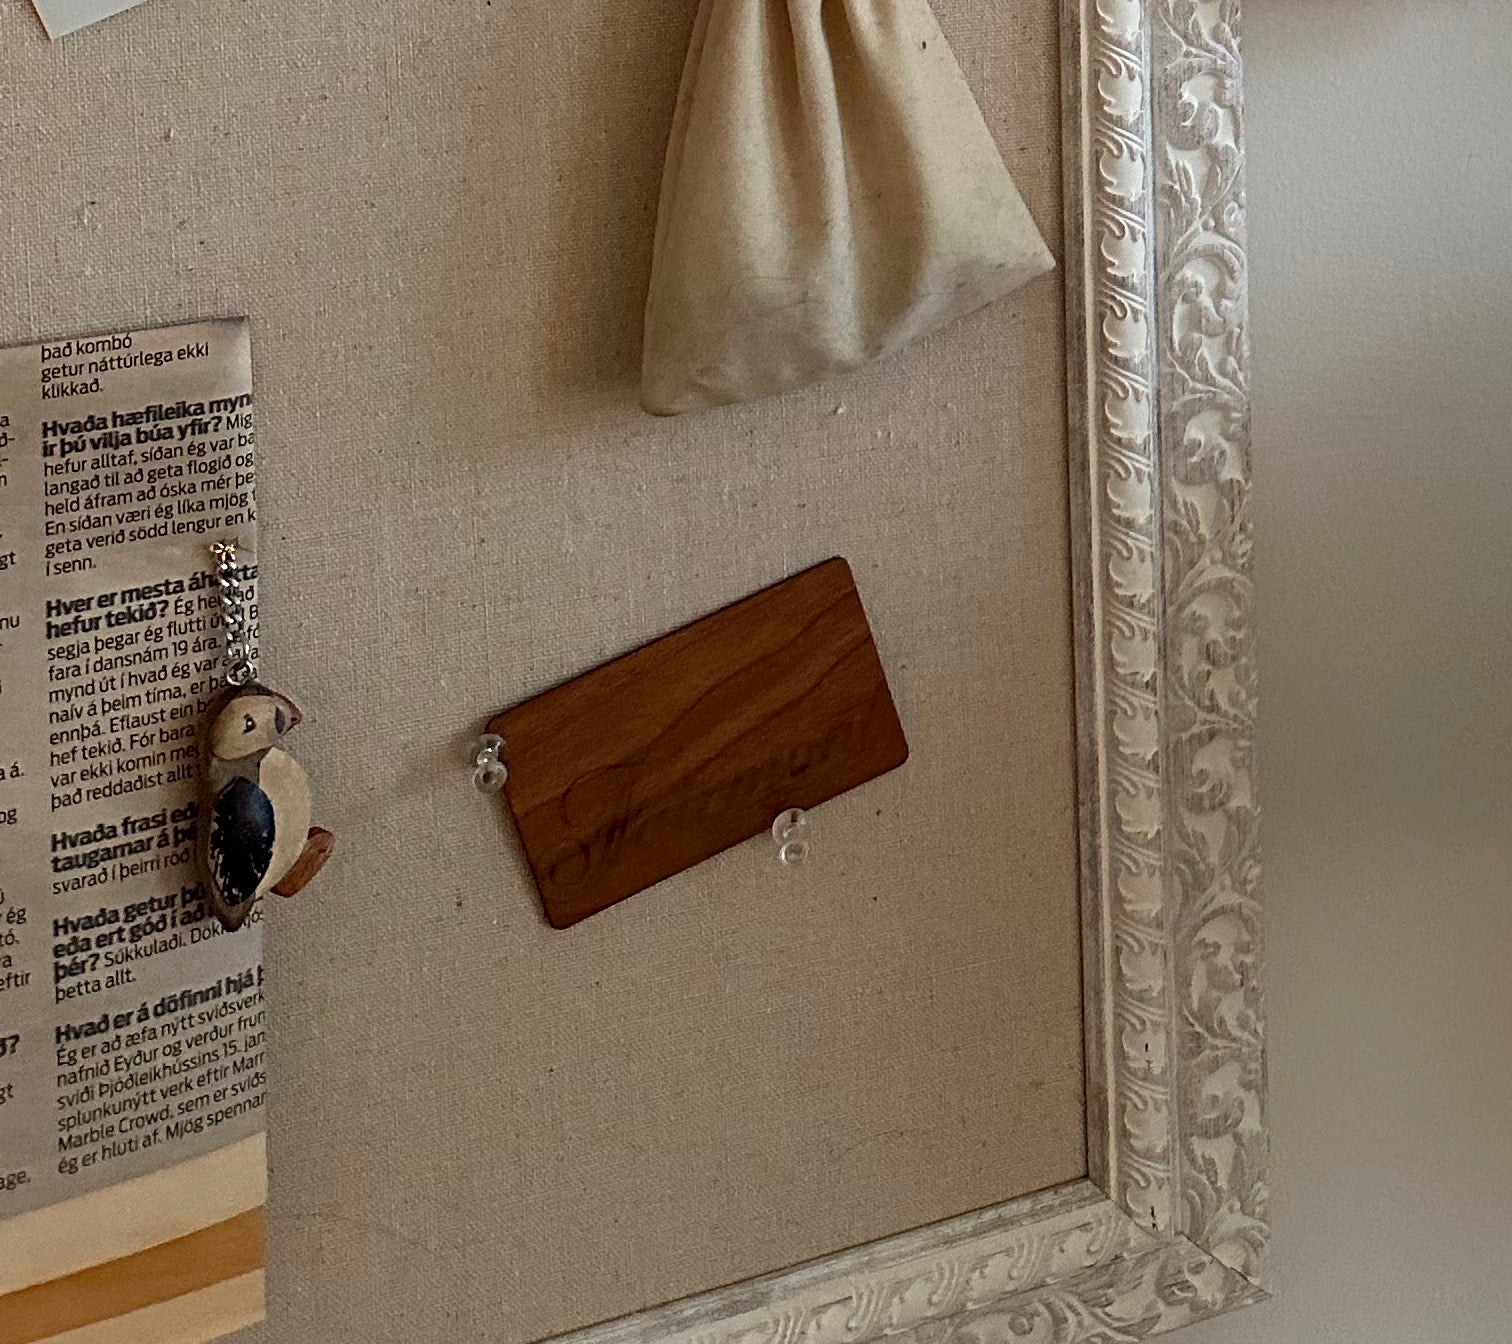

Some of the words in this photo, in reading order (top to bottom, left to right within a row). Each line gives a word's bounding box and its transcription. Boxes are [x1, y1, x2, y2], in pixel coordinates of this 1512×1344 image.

[41, 362, 85, 382] getur
[88, 350, 173, 375] náttúrlega
[177, 342, 209, 360] ekki
[42, 342, 72, 362] það
[76, 332, 132, 355] kombó
[42, 379, 103, 399] klikkað.
[42, 415, 107, 438] Hvaða
[111, 399, 205, 428] hæfileika
[60, 435, 86, 458] þú
[89, 430, 132, 451] vilja
[135, 424, 174, 444] búa
[177, 416, 222, 441] yfir?
[226, 413, 252, 430] Mig
[44, 457, 87, 477] hefur
[141, 445, 183, 463] síðan
[187, 441, 206, 457] ég
[209, 437, 234, 452] var
[44, 476, 100, 496] langað
[104, 470, 119, 487] til
[124, 468, 144, 484] að
[147, 464, 183, 483] geta
[187, 455, 231, 474] flogið
[235, 452, 253, 468] og
[44, 497, 80, 516] held
[84, 491, 132, 509] áfram
[137, 488, 156, 502] að
[160, 481, 197, 498] óska
[200, 476, 231, 492] mér
[45, 521, 65, 536] En
[69, 514, 112, 533] síðan
[116, 507, 150, 524] væri
[154, 503, 173, 519] ég
[177, 498, 205, 514] líka
[209, 493, 248, 511] mjög
[45, 538, 82, 558] geta
[87, 528, 125, 548] verið
[129, 522, 168, 542] södd
[172, 516, 221, 534] lengur
[224, 512, 244, 527] en
[53, 556, 97, 575] senn.
[45, 596, 93, 619] Hver
[97, 591, 118, 609] er
[120, 579, 185, 605] mesta
[46, 616, 102, 639] hefur
[105, 600, 169, 628] tekið?
[174, 597, 194, 616] Ég
[48, 644, 90, 662] segja
[94, 632, 141, 654] þegar
[144, 629, 163, 645] ég
[166, 617, 207, 637] flutti
[48, 664, 82, 682] fara
[93, 647, 169, 673] dansnám
[172, 640, 188, 657] 19
[192, 637, 221, 653] ára.
[49, 682, 95, 705] mynd
[100, 676, 116, 693] út
[128, 664, 168, 686] hvað
[171, 662, 190, 679] ég
[194, 657, 219, 673] var
[102, 694, 142, 715] þeim
[190, 680, 205, 694] er
[110, 713, 167, 733] Eflaust
[50, 747, 82, 766] hef
[82, 739, 126, 760] tekið.
[130, 731, 156, 750] Fór
[160, 724, 195, 743] bara
[50, 770, 76, 788] var
[80, 760, 113, 780] ekki
[117, 751, 166, 773] komin
[52, 788, 82, 811] það
[166, 763, 193, 782] allt
[51, 824, 118, 852] Hvaða
[121, 808, 167, 836] frasi
[52, 871, 108, 894] svarað
[53, 908, 120, 937] Hvaða
[53, 936, 91, 959] eða
[95, 927, 126, 950] ert
[53, 955, 100, 983] þér?
[55, 980, 101, 1004] þetta
[105, 968, 136, 989] allt.
[55, 1014, 110, 1044] Hvað
[113, 1010, 134, 1030] er
[225, 970, 254, 994] hjá
[57, 1044, 77, 1067] Ég
[81, 1044, 97, 1060] er
[101, 1035, 121, 1053] að
[125, 1028, 158, 1048] æfa
[161, 1014, 194, 1037] nýtt
[57, 1059, 109, 1088] nafnið
[114, 1047, 159, 1072] Eyður
[162, 1041, 182, 1057] og
[185, 1022, 233, 1049] verður
[58, 1090, 156, 1132] splunkunýtt
[160, 1077, 193, 1100] verk
[197, 1064, 230, 1087] eftir
[58, 1123, 114, 1152] Marble
[177, 1095, 210, 1115] sem
[213, 1087, 228, 1102] er
[101, 1138, 139, 1161] hluti
[165, 1116, 203, 1140] Mjög
